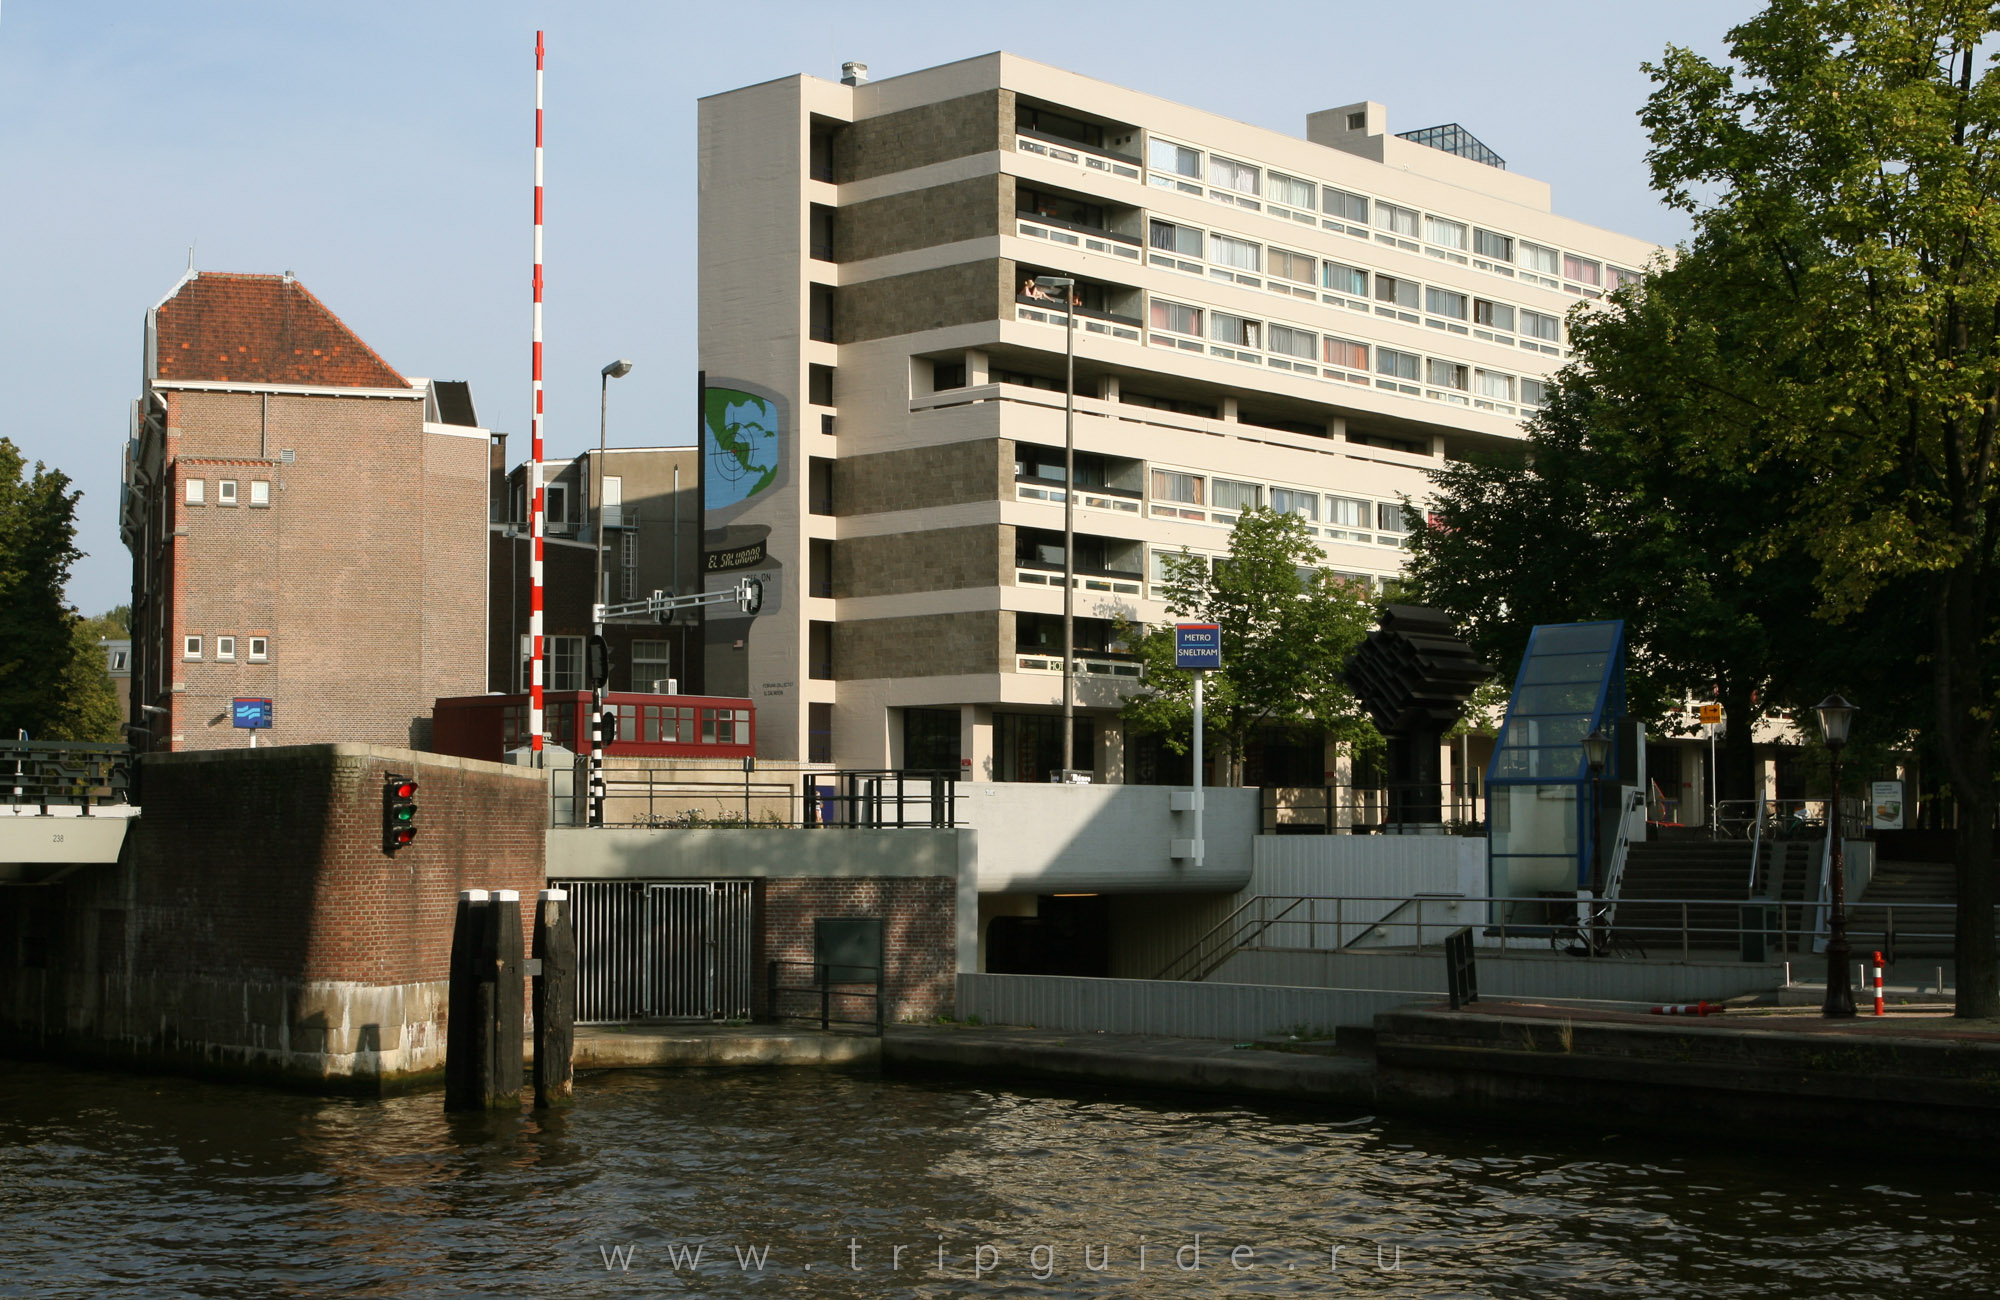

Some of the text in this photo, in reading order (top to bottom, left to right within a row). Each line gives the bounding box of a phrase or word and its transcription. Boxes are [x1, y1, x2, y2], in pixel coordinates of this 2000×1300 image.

[708, 554, 718, 569] EL
[761, 572, 771, 582] ON
[1184, 633, 1211, 642] METRO
[1178, 648, 1218, 657] SNELTRAM
[52, 834, 64, 843] 238
